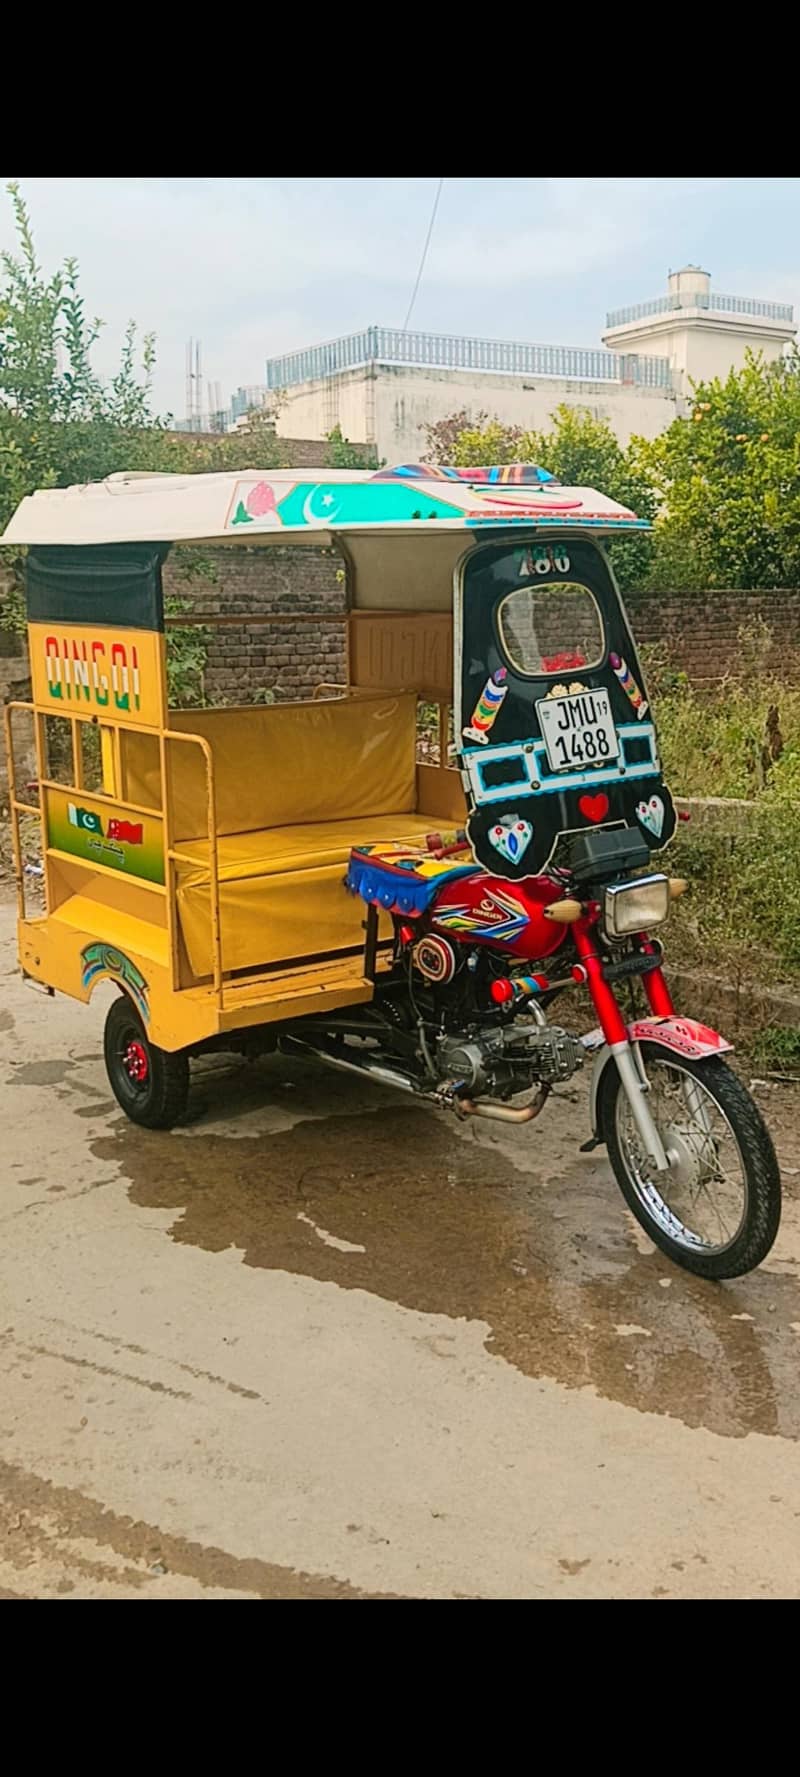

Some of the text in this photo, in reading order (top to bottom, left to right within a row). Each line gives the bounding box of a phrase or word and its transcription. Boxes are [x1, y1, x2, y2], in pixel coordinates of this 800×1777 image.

[46, 636, 140, 712] QINGQI
[557, 696, 608, 730] JMU 19
[555, 728, 610, 765] 1488
